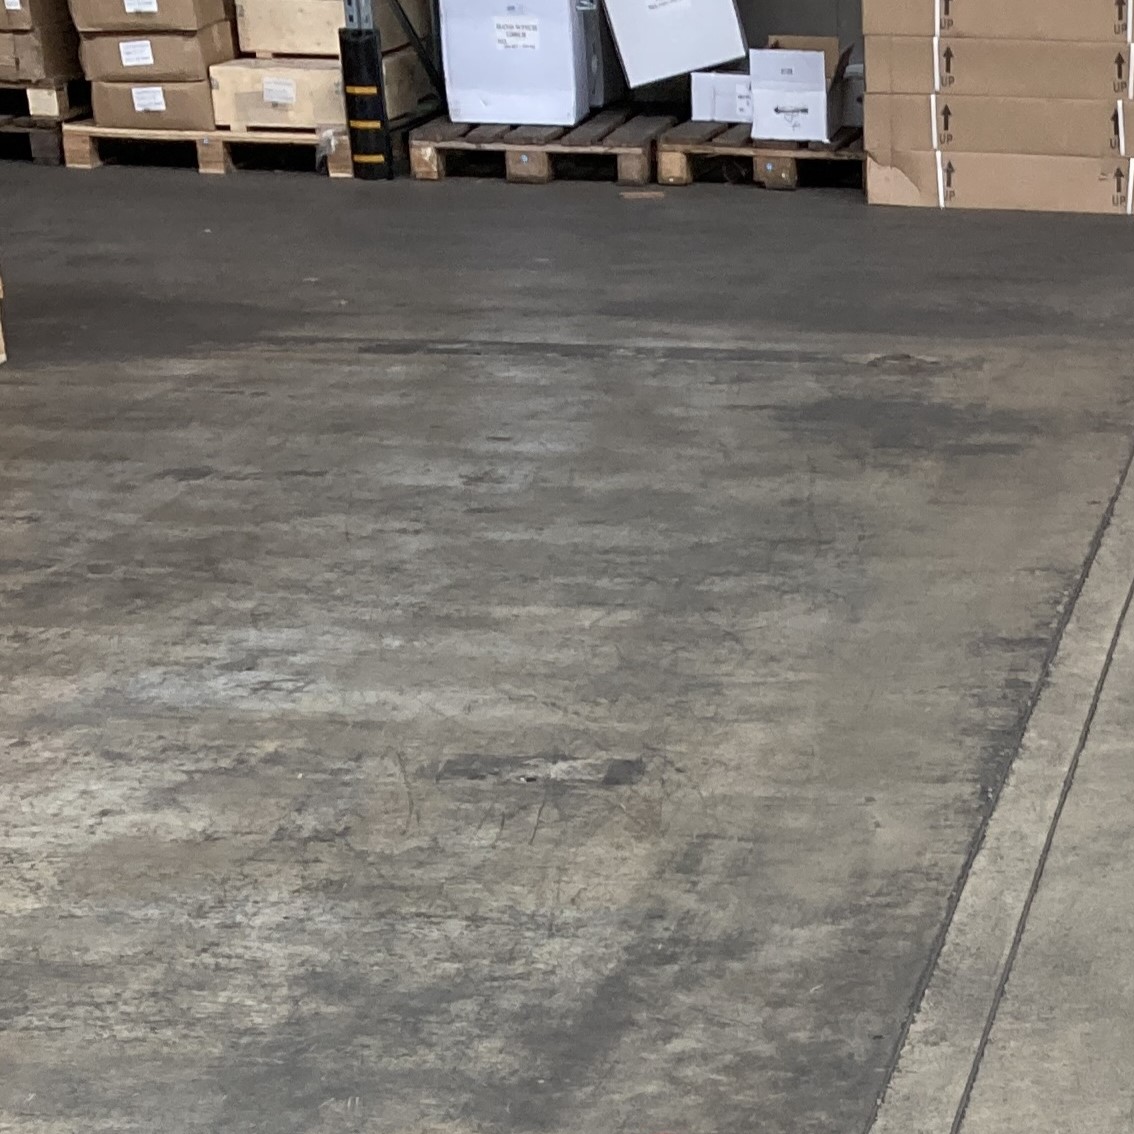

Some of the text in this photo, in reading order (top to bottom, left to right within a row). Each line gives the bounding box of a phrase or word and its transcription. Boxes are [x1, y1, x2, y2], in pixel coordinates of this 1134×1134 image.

[940, 18, 953, 30] UP
[1114, 24, 1127, 35] UP
[941, 76, 955, 87] UP
[1113, 81, 1127, 93] UP
[940, 133, 953, 145] UP
[1112, 195, 1126, 206] UP
